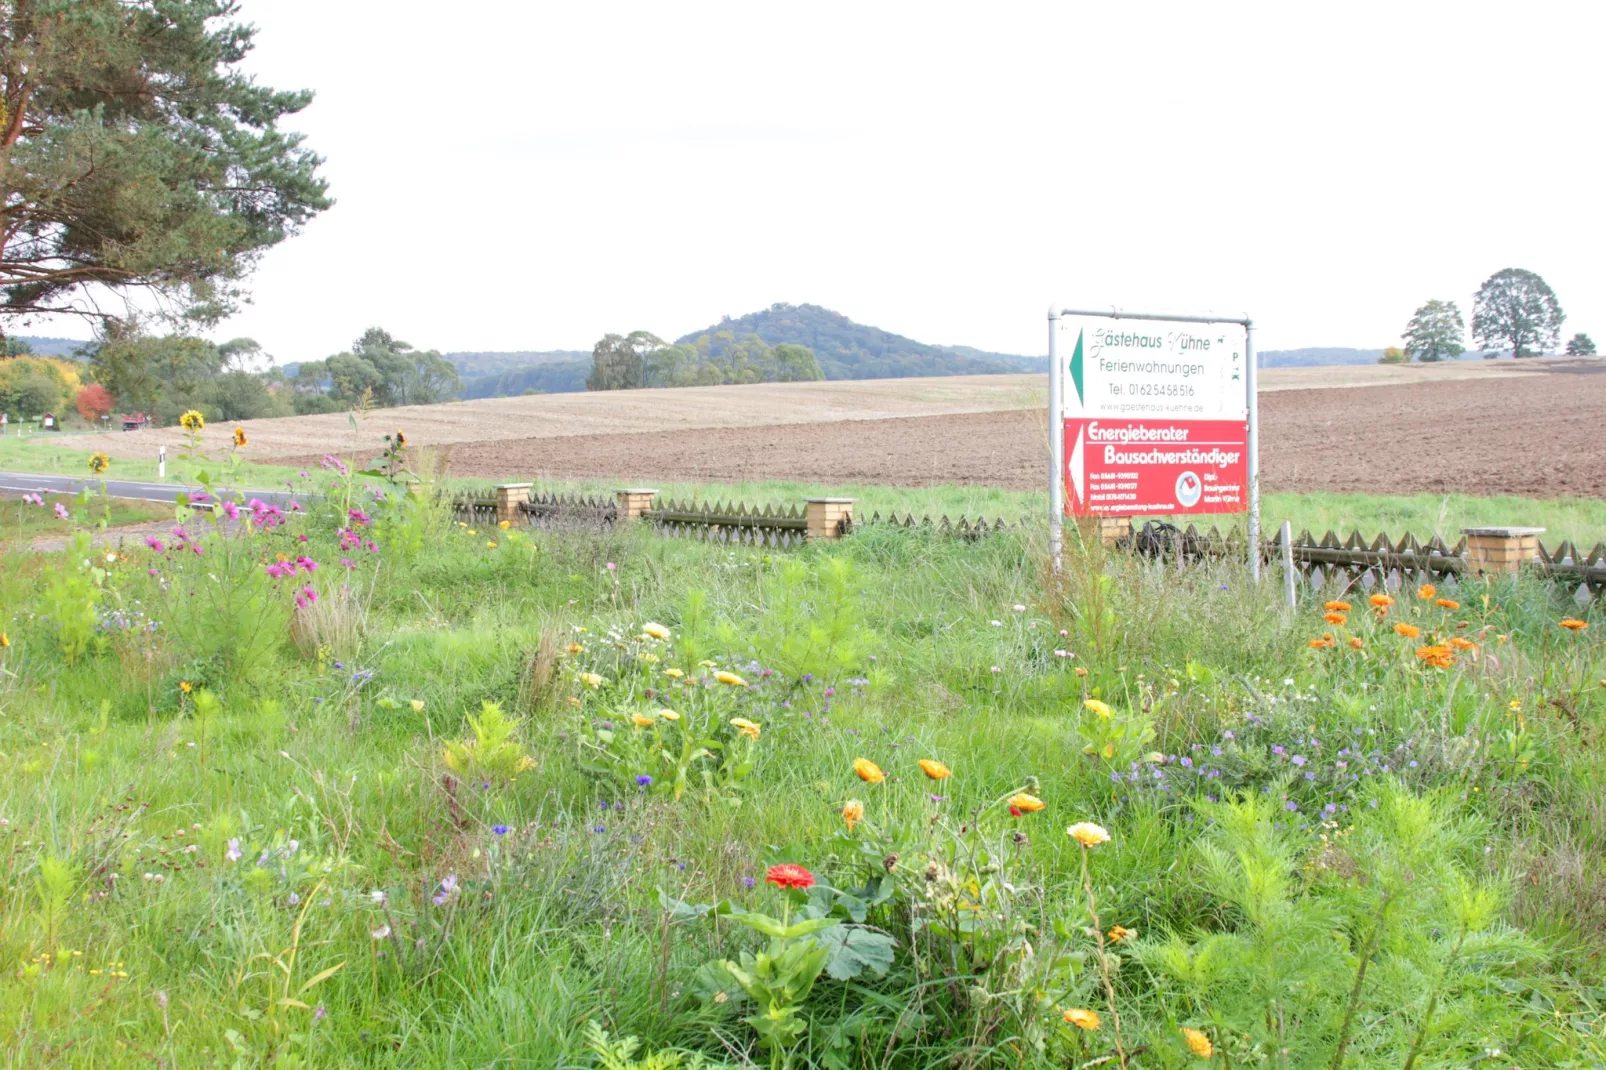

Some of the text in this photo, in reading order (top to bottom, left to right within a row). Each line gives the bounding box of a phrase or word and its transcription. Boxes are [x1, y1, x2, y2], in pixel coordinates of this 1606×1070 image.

[1090, 328, 1162, 358] Gästehaus
[1100, 358, 1205, 378] Ferienwohnungen
[1109, 383, 1195, 397] Tel. 01625458516
[1100, 403, 1204, 413] www.gaestehaus-kuehne.de
[1088, 421, 1189, 445] Energieberater
[1104, 445, 1241, 468] Bausachverständiger
